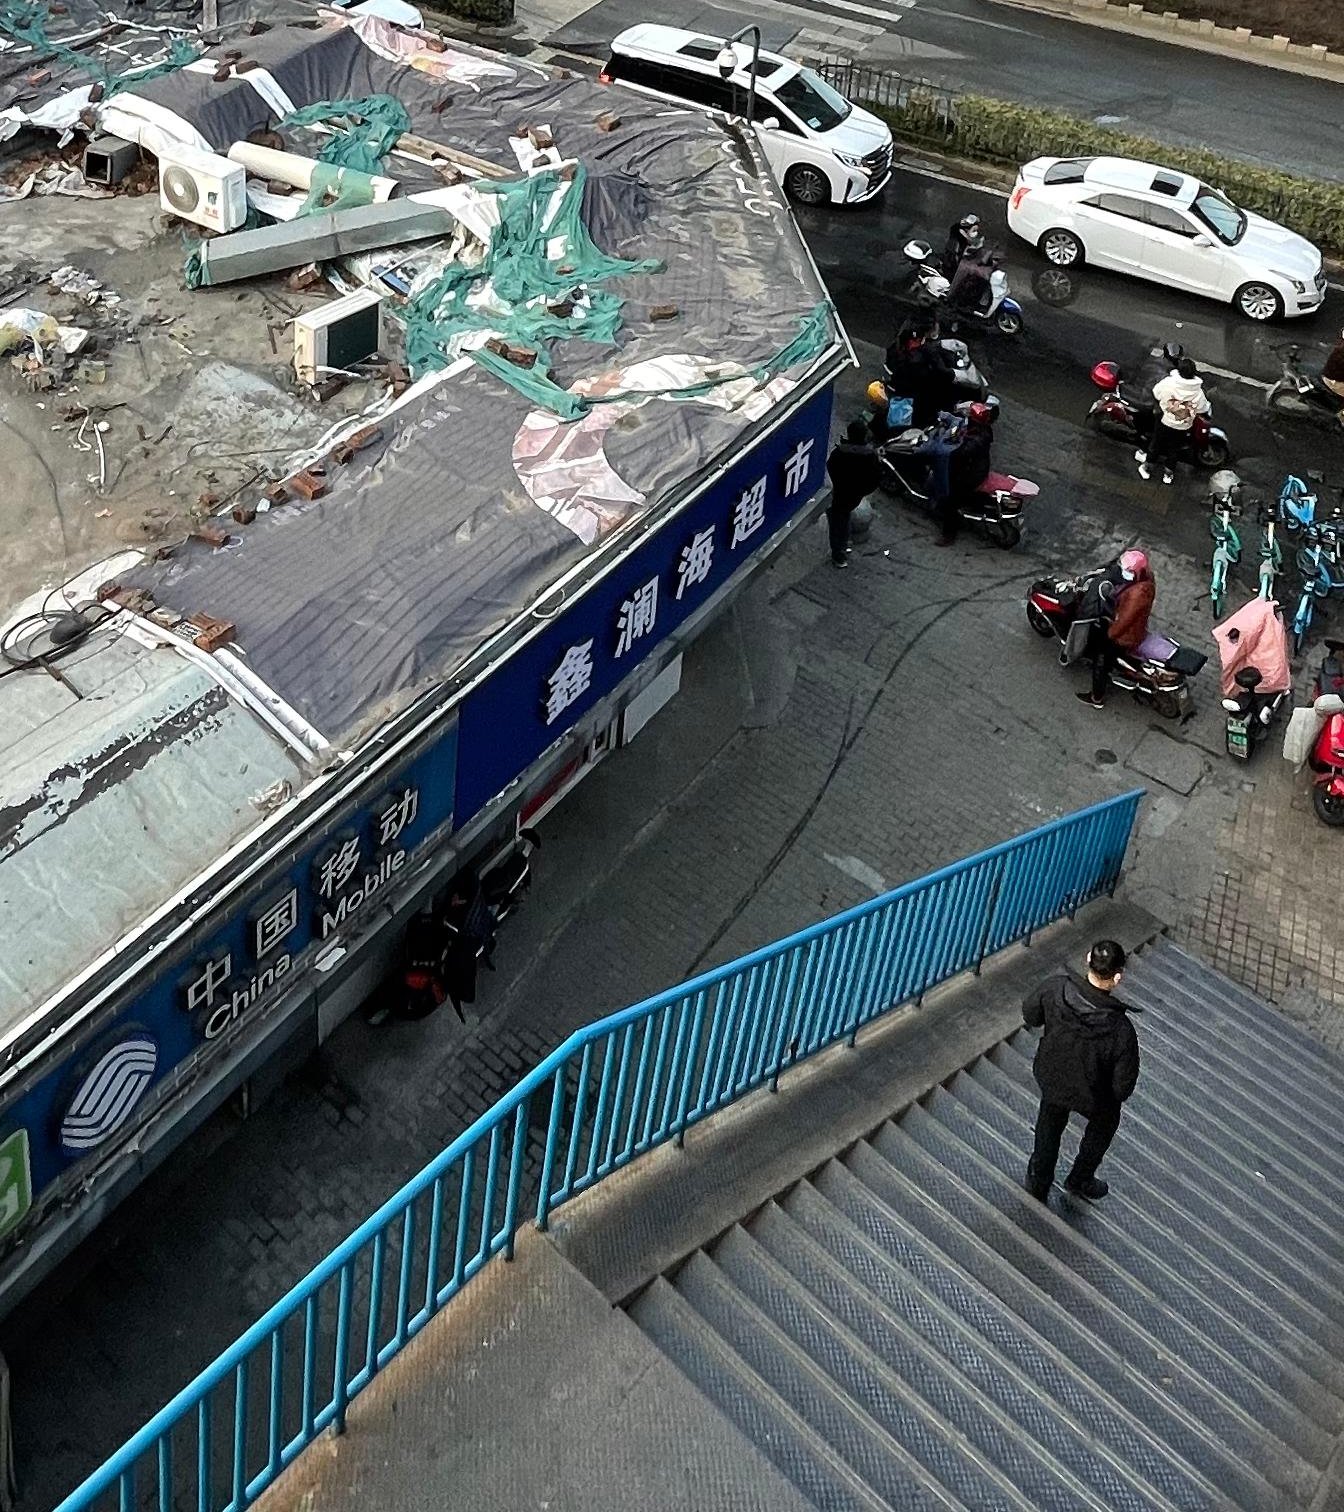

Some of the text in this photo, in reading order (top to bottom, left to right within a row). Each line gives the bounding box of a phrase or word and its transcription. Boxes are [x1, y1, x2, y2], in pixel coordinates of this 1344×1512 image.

[546, 438, 814, 726] 鑫澜海超市
[187, 788, 418, 1011] 中国移动
[204, 849, 406, 1040] China Mobile
